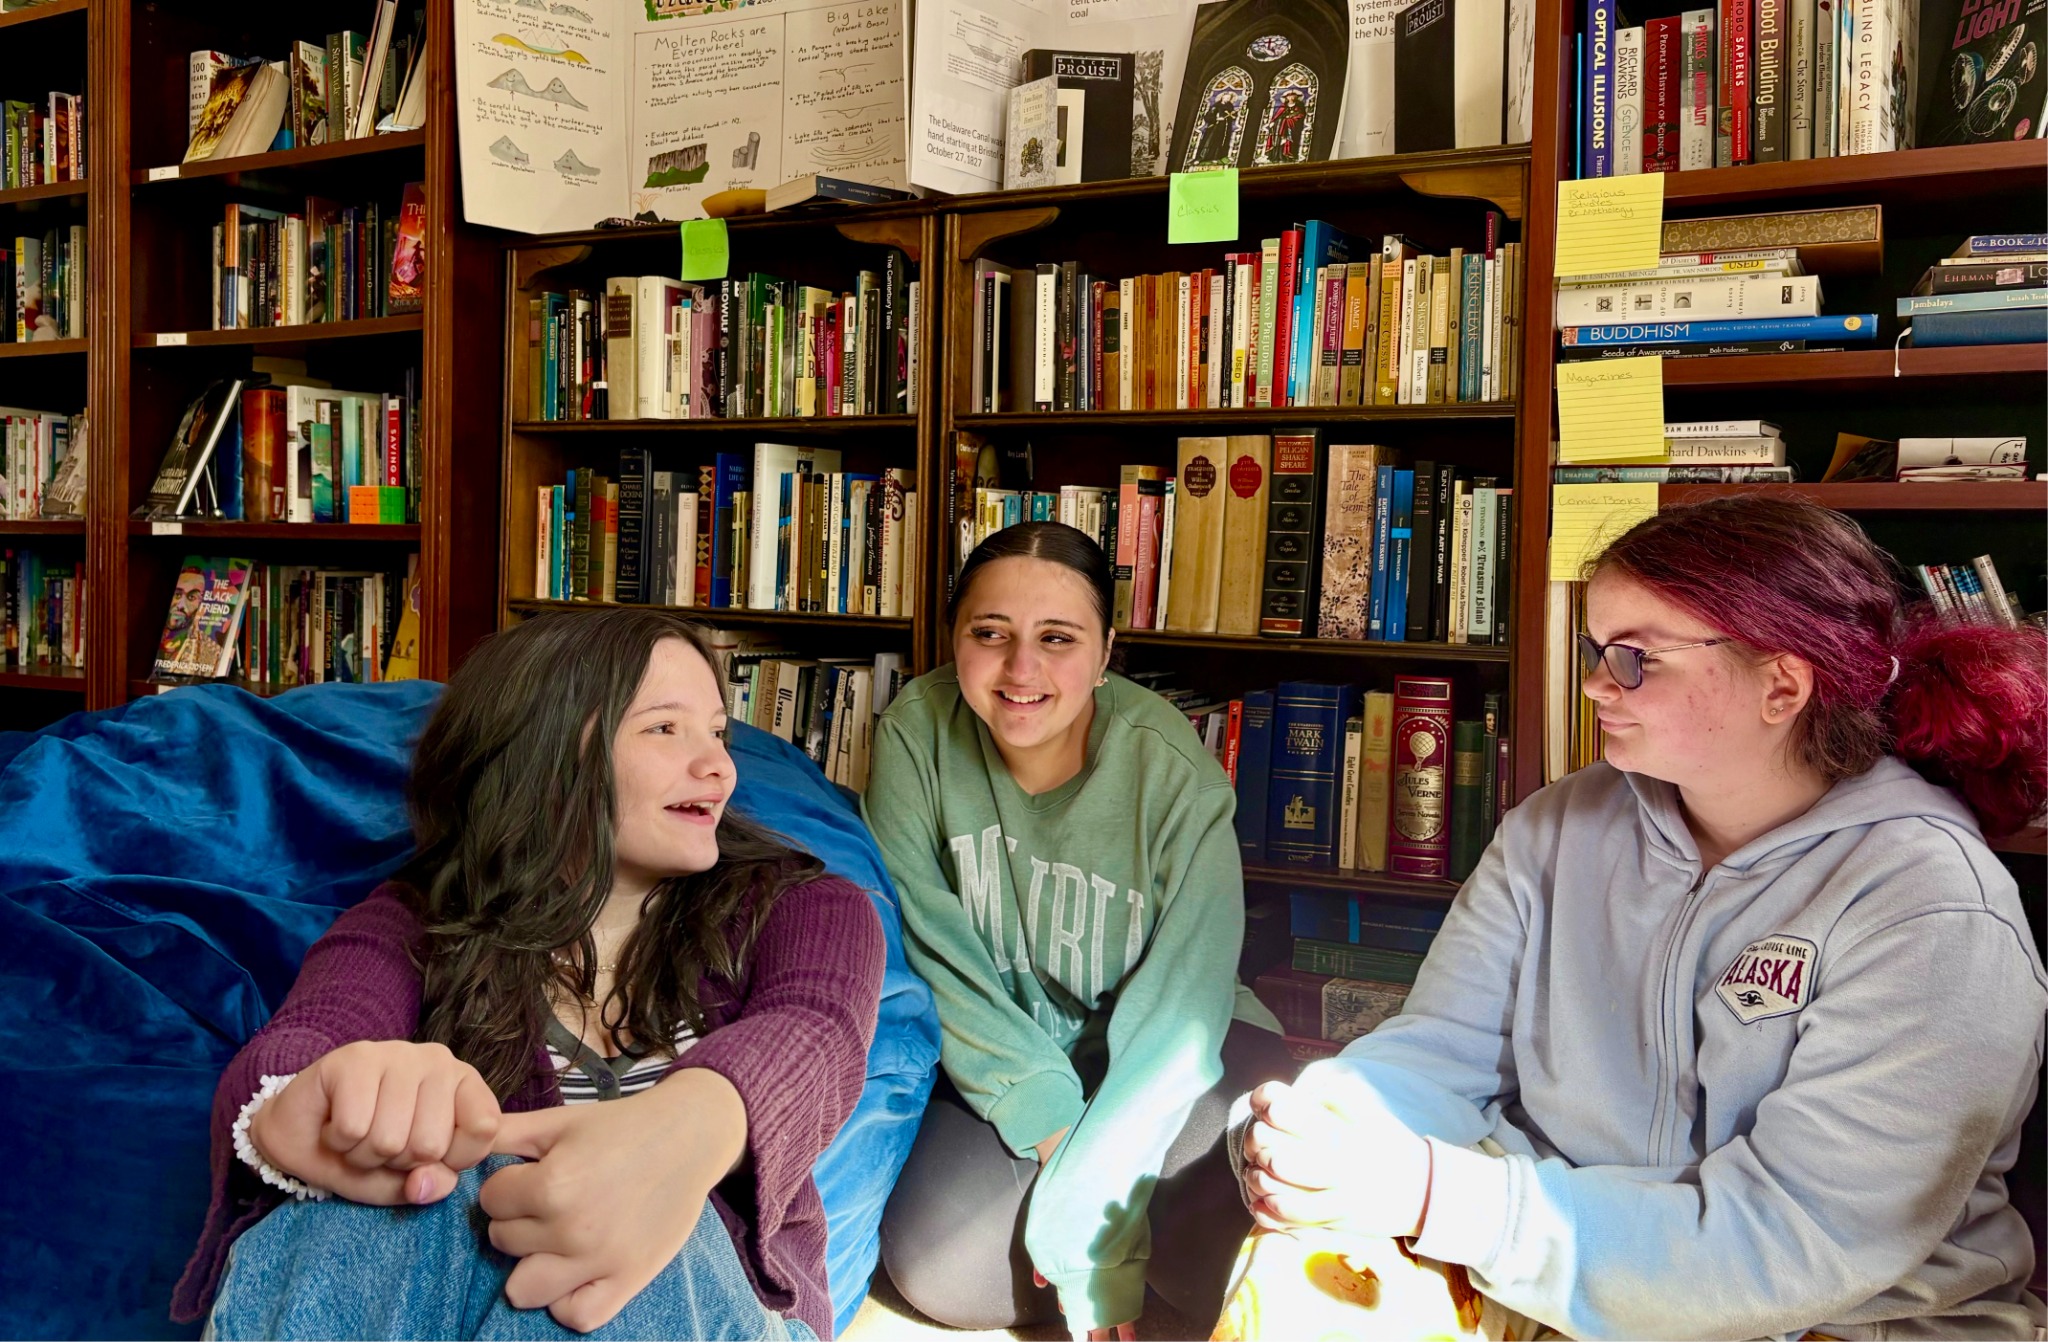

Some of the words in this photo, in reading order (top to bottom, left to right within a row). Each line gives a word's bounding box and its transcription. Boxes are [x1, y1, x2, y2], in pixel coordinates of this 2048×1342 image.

[827, 12, 850, 26] Big
[858, 5, 889, 18] Lake
[1070, 8, 1088, 18] coal
[1355, 16, 1366, 26] to
[1368, 12, 1385, 24] the
[1408, 3, 1443, 32] PROUST
[1736, 1, 1744, 33] ROBO
[1760, 0, 1778, 36] obot
[654, 35, 706, 51] Molten
[710, 28, 745, 43] Rocks
[750, 26, 766, 36] are
[1354, 27, 1371, 40] the
[1374, 26, 1388, 36] NJ
[1594, 8, 1606, 70] OPTICAL
[1695, 25, 1707, 59] PHYSICS
[303, 50, 318, 64] The
[672, 39, 744, 60] Everywhere!
[1660, 34, 1668, 70] PEOPLE'S
[193, 62, 206, 74] 100
[1057, 64, 1116, 77] PROUST
[1736, 36, 1744, 87] SAPIENS
[1618, 47, 1628, 100] DAWKINS
[1628, 47, 1638, 97] RICHARD
[1756, 39, 1778, 104] Building
[1658, 72, 1668, 107] HISTORY
[1794, 79, 1808, 102] Story
[1860, 53, 1872, 110] LEGACY
[1592, 74, 1606, 149] ILLUSIONS
[1658, 110, 1665, 120] OF
[1768, 108, 1776, 117] for
[928, 114, 942, 128] The
[942, 118, 972, 137] Delaware
[972, 129, 991, 143] Canal
[991, 138, 1003, 147] was
[1622, 109, 1632, 152] SCIENCE
[1758, 108, 1768, 140] Beginners
[927, 128, 946, 144] hand,
[946, 135, 970, 154] starting
[970, 143, 978, 152] at
[978, 145, 999, 161] Bristol
[1657, 122, 1666, 157] SCIENCE
[926, 143, 954, 161] October
[1568, 199, 1613, 209] Studies
[1569, 188, 1627, 201] Religious
[1583, 206, 1634, 218] Mythology
[1990, 238, 2025, 247] BOOK
[1670, 256, 1698, 266] Distress
[1728, 260, 1760, 270] USED
[1283, 245, 1293, 297] TYRANT
[1590, 272, 1628, 280] ESSENTIAL
[1628, 270, 1658, 278] MENGZI
[1944, 274, 1994, 283] EHRMAN
[886, 270, 894, 309] Canterbury
[1264, 268, 1276, 298] PRIDE
[1468, 272, 1480, 306] KING
[721, 280, 729, 333] BEOWULF
[1352, 298, 1360, 330] HAMLET
[1382, 290, 1392, 326] JULIUS
[1910, 299, 1954, 310] Jambalaya
[1416, 300, 1428, 348] SHAKESPEARE
[1468, 310, 1479, 343] LEAR
[1590, 324, 1690, 341] BUDDHISM
[1261, 322, 1273, 375] PREJUDICE
[1380, 330, 1391, 369] CAESAR
[1602, 347, 1625, 358] Seeds
[1626, 346, 1638, 357] of
[1638, 346, 1681, 357] Awareness
[1234, 356, 1242, 378] USED
[1416, 356, 1424, 381] Macbeth
[1566, 372, 1634, 388] Magazines
[1281, 454, 1308, 462] SHAKE-
[1664, 445, 1694, 458] chard
[1697, 446, 1747, 458] Dawkins
[1280, 461, 1306, 469] SPEARE
[1350, 470, 1366, 481] The
[620, 490, 643, 498] DICKENS
[1340, 480, 1360, 492] Tale
[1350, 492, 1359, 502] of
[1558, 495, 1599, 506] Comic
[1602, 495, 1642, 506] Books
[832, 513, 840, 536] GATSBY
[866, 522, 876, 548] Johnny
[831, 540, 840, 577] FITZGERALD
[1438, 553, 1444, 564] OF
[1476, 554, 1486, 594] Treasure
[214, 578, 230, 590] THE
[204, 590, 234, 603] BLACK
[198, 602, 231, 616] FRIEND
[1475, 596, 1486, 624] Island
[154, 658, 189, 670] FREDERICK
[190, 662, 214, 674] JOSEPH
[764, 688, 775, 716] ILIAD
[1285, 737, 1325, 748] TWAIN
[1288, 729, 1321, 739] MARK
[1347, 756, 1356, 768] Eight
[1346, 770, 1354, 783] Great
[1398, 772, 1430, 786] JULES
[1408, 785, 1442, 798] VERNE
[1416, 810, 1440, 819] Novels
[1786, 944, 1808, 960] LINE
[1720, 954, 1806, 1005] ALASKA
